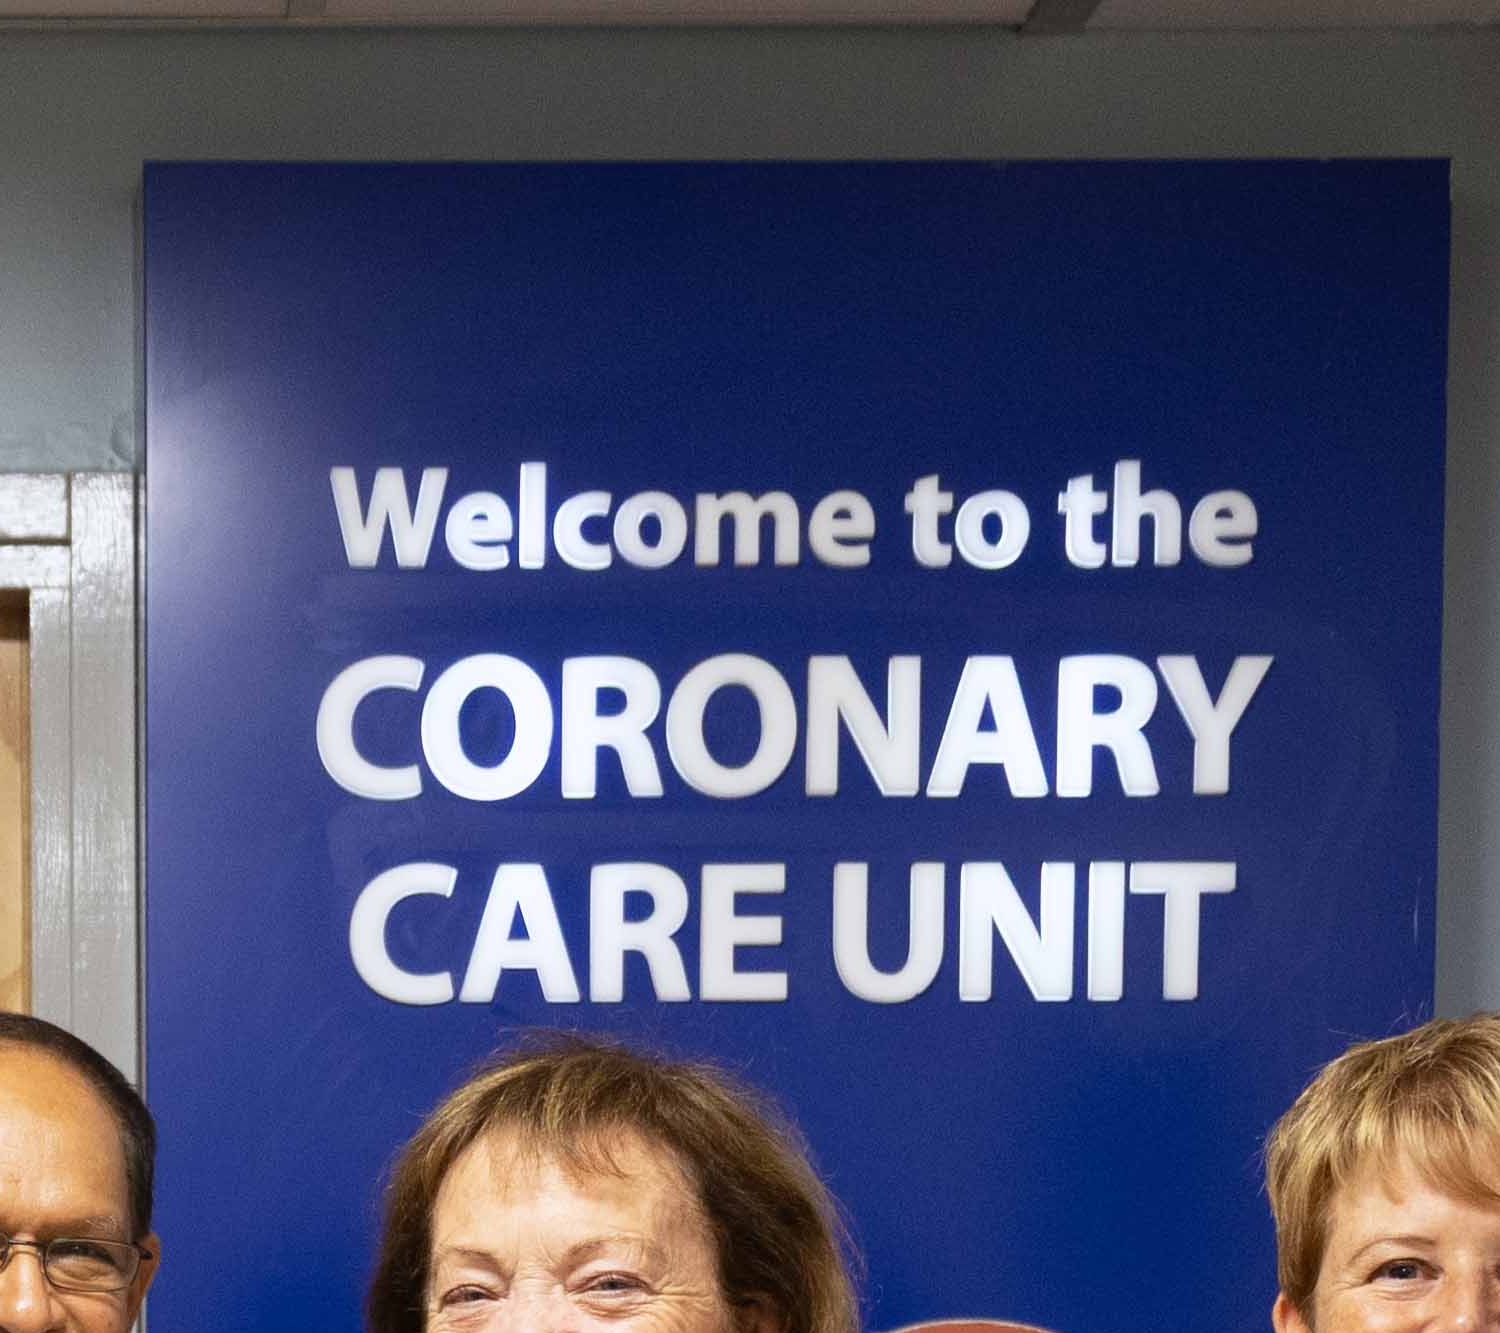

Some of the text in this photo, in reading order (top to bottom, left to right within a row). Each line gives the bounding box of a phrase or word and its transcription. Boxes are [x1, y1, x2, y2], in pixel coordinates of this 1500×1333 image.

[329, 459, 1259, 571] Welcome to the
[316, 652, 1274, 800] CORONARY
[348, 860, 1237, 1006] CARE UNIT
